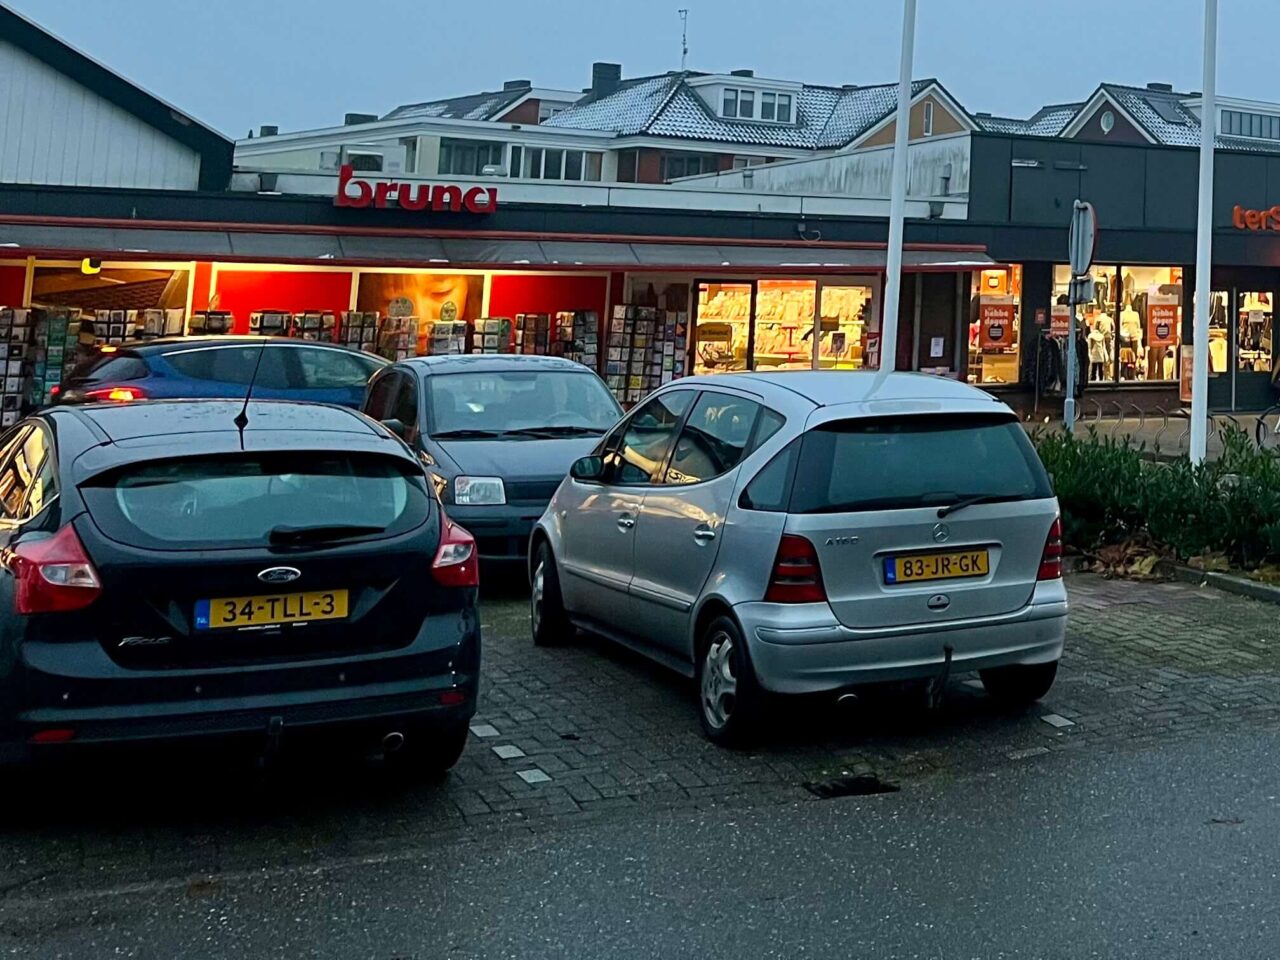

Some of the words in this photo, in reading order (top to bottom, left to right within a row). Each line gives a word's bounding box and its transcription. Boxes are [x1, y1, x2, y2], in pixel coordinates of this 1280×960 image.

[334, 164, 498, 214] bruna
[903, 554, 981, 577] 83-JR-GK
[222, 593, 335, 623] 34-TLL-3
